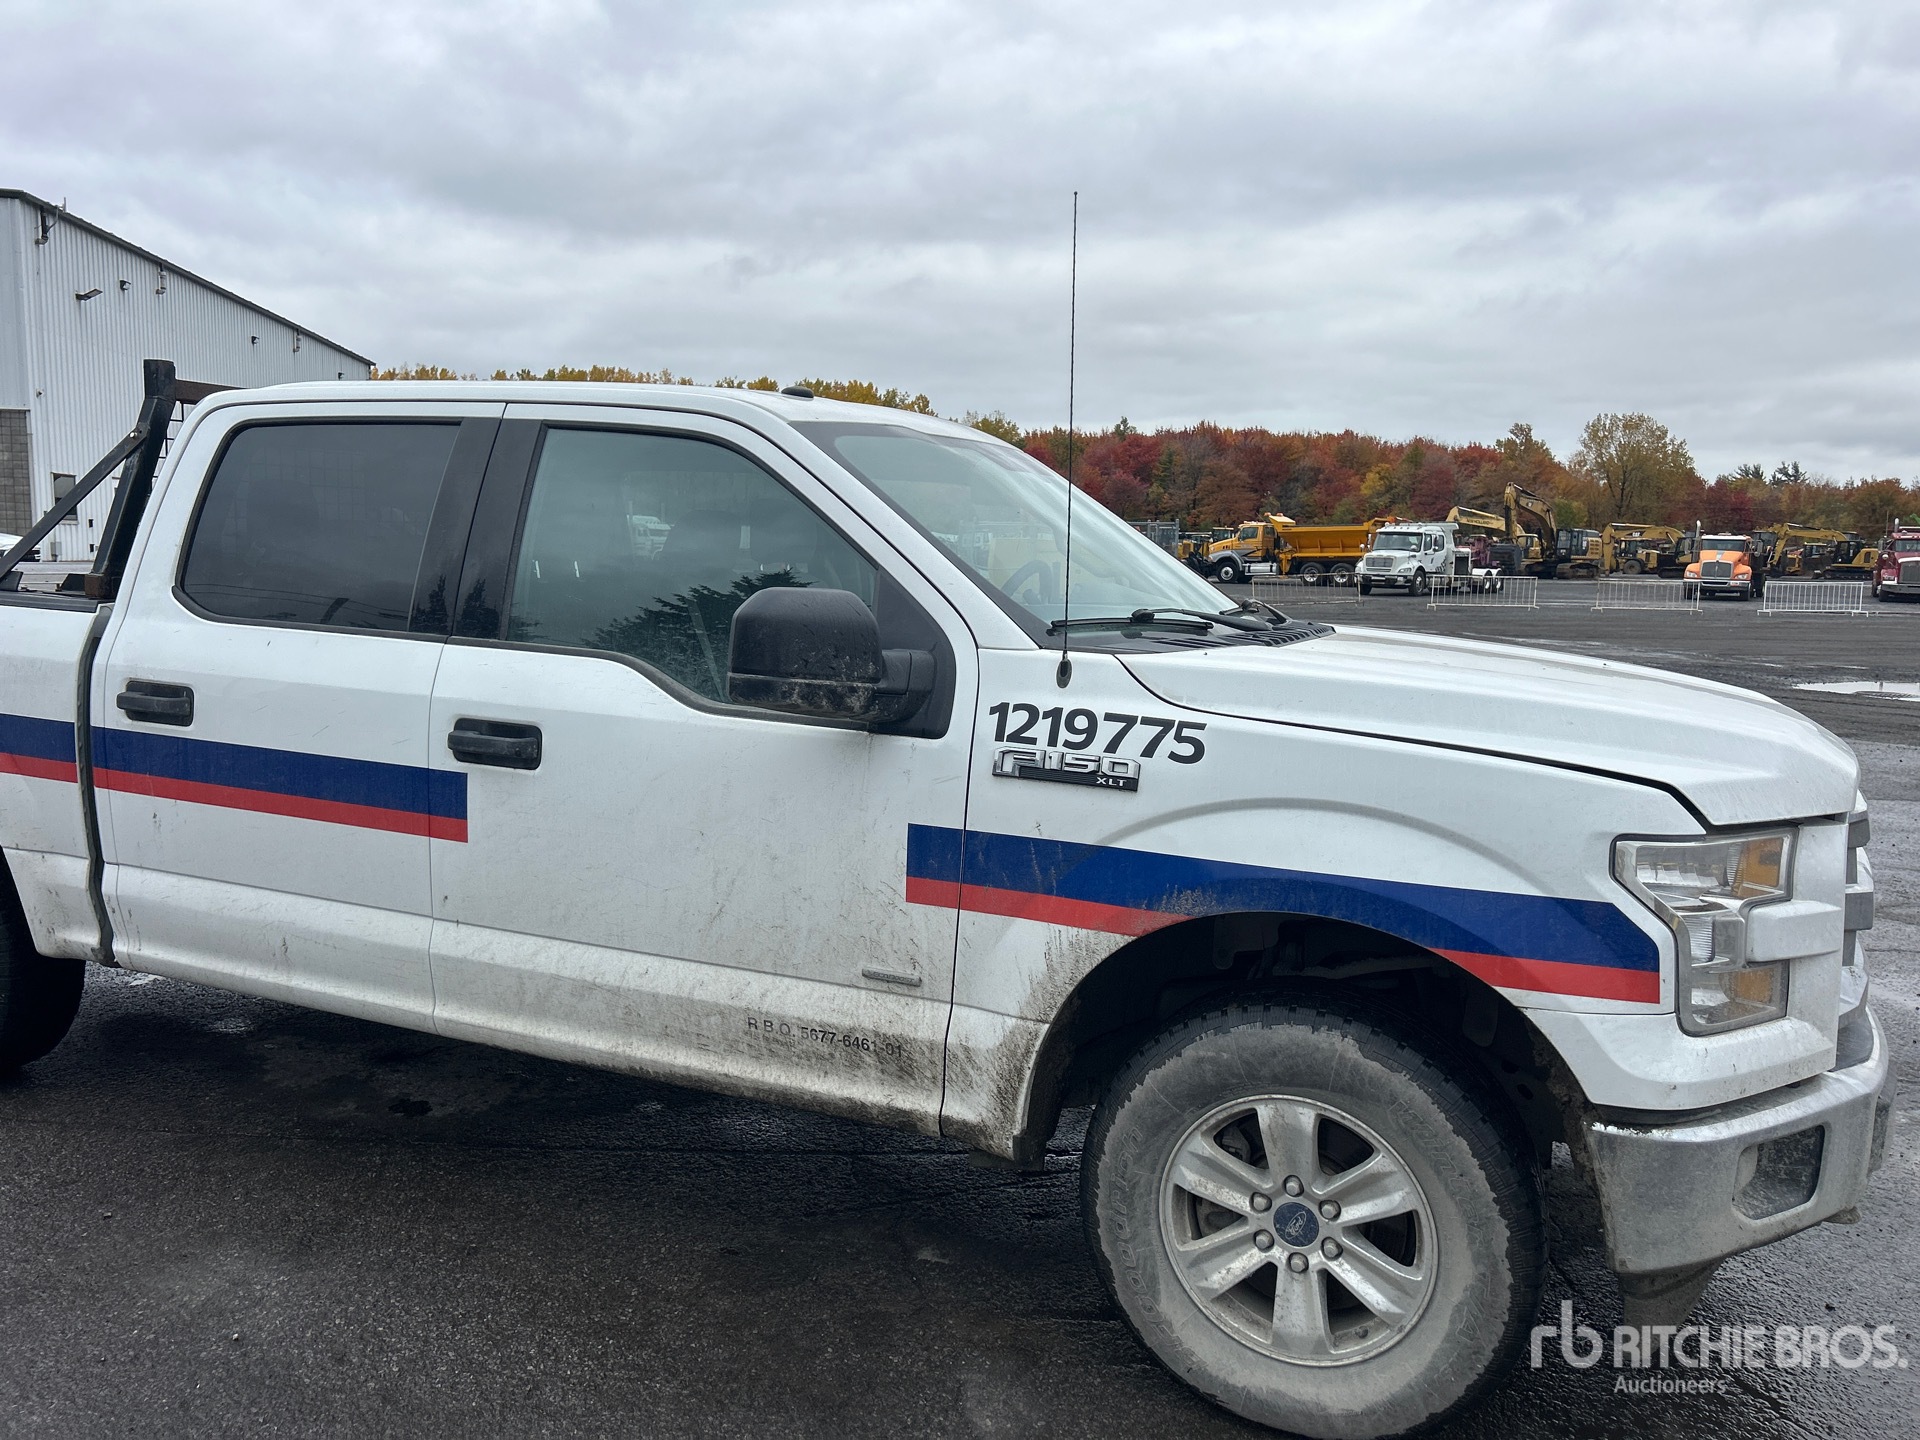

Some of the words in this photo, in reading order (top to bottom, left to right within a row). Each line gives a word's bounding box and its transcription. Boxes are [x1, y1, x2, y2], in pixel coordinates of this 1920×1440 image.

[988, 701, 1208, 765] 1219775
[1096, 776, 1127, 787] XLT
[1287, 1214, 1304, 1237] Ford
